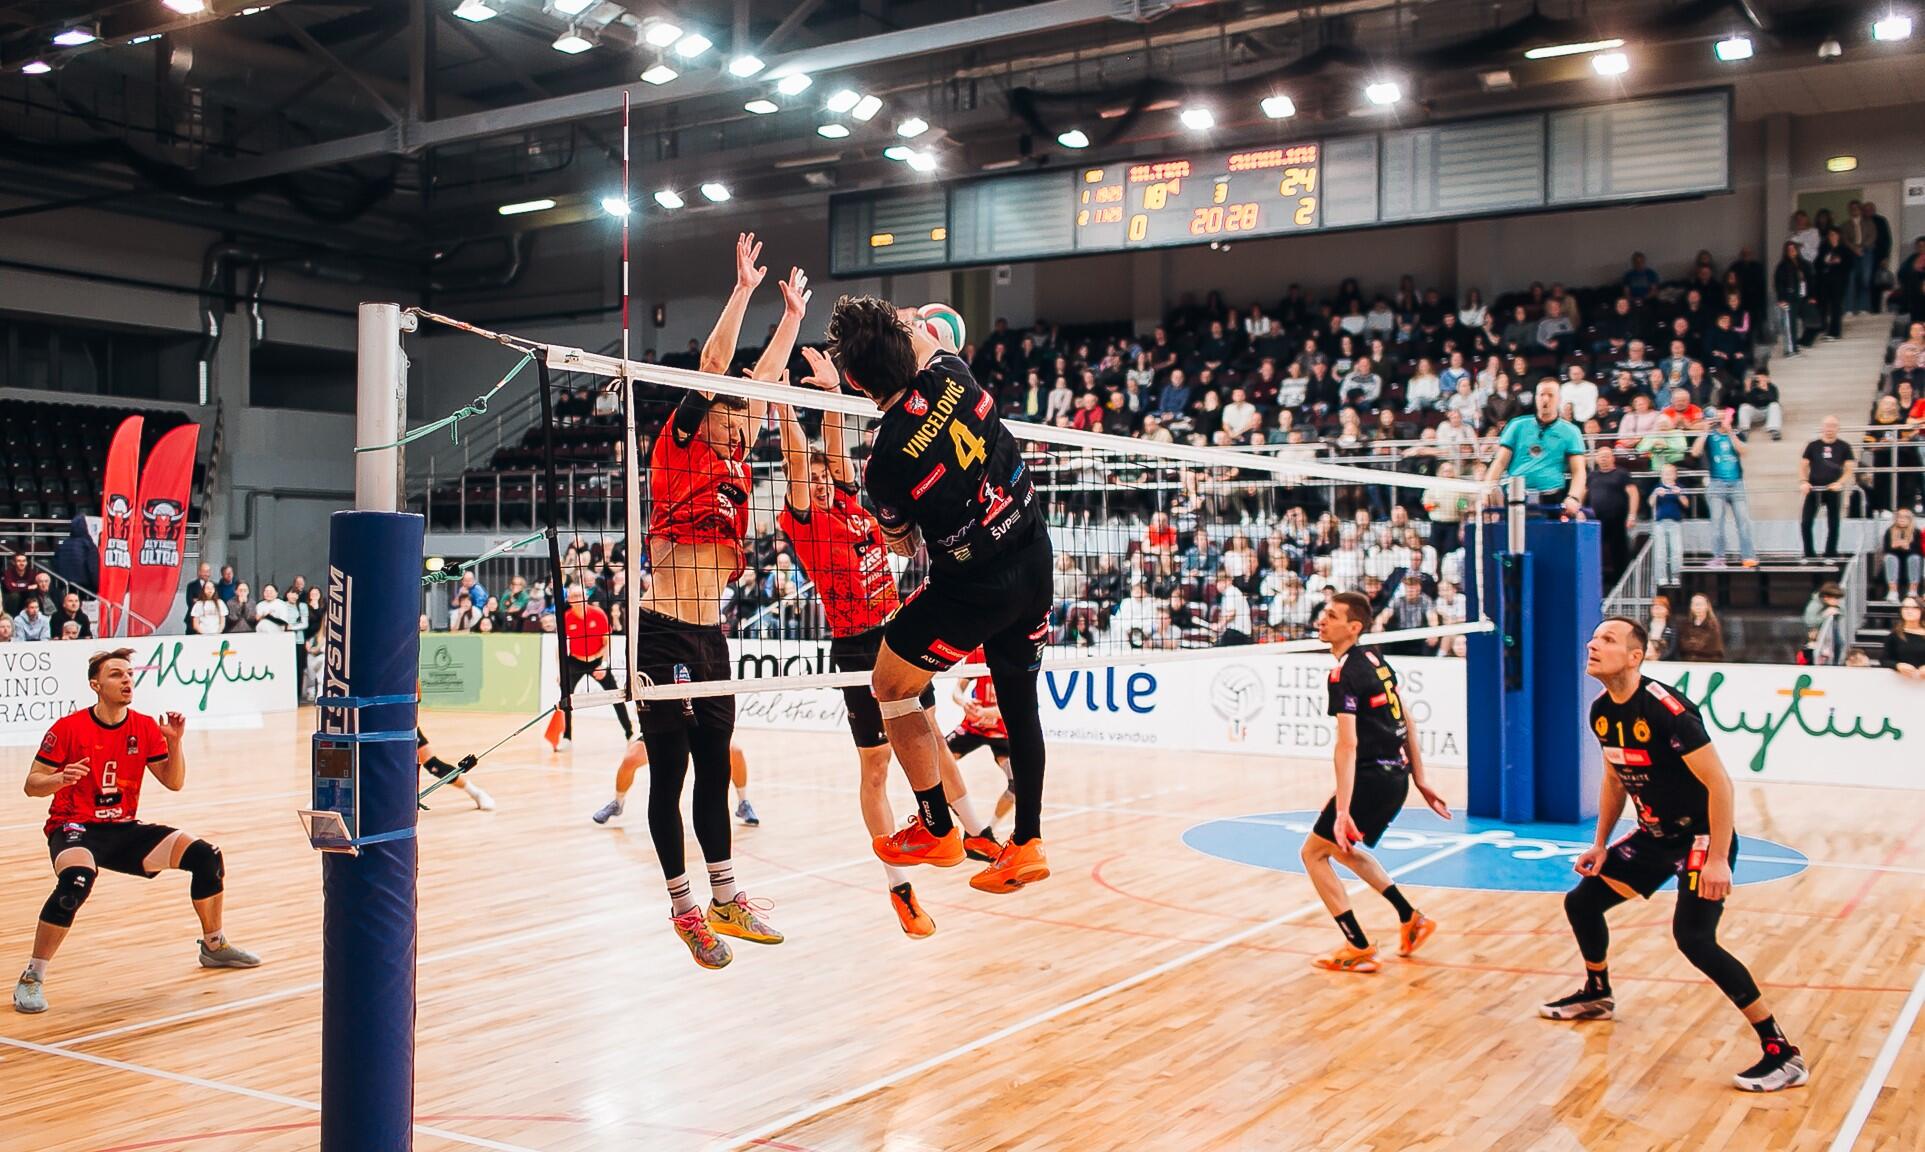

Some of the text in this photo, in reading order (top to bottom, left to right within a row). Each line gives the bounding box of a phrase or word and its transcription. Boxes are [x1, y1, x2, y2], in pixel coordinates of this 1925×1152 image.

[1214, 183, 1228, 203] 3
[1280, 167, 1316, 196] 24
[1129, 215, 1148, 240] 0
[1190, 206, 1224, 234] 20
[1294, 197, 1316, 225] 2
[949, 419, 987, 470] 4
[140, 549, 179, 566] ULTRA
[3, 652, 51, 672] VOS
[134, 640, 274, 711] Alytus
[0, 676, 58, 697] INIO
[1616, 720, 1625, 747] 1
[102, 761, 117, 787] 6
